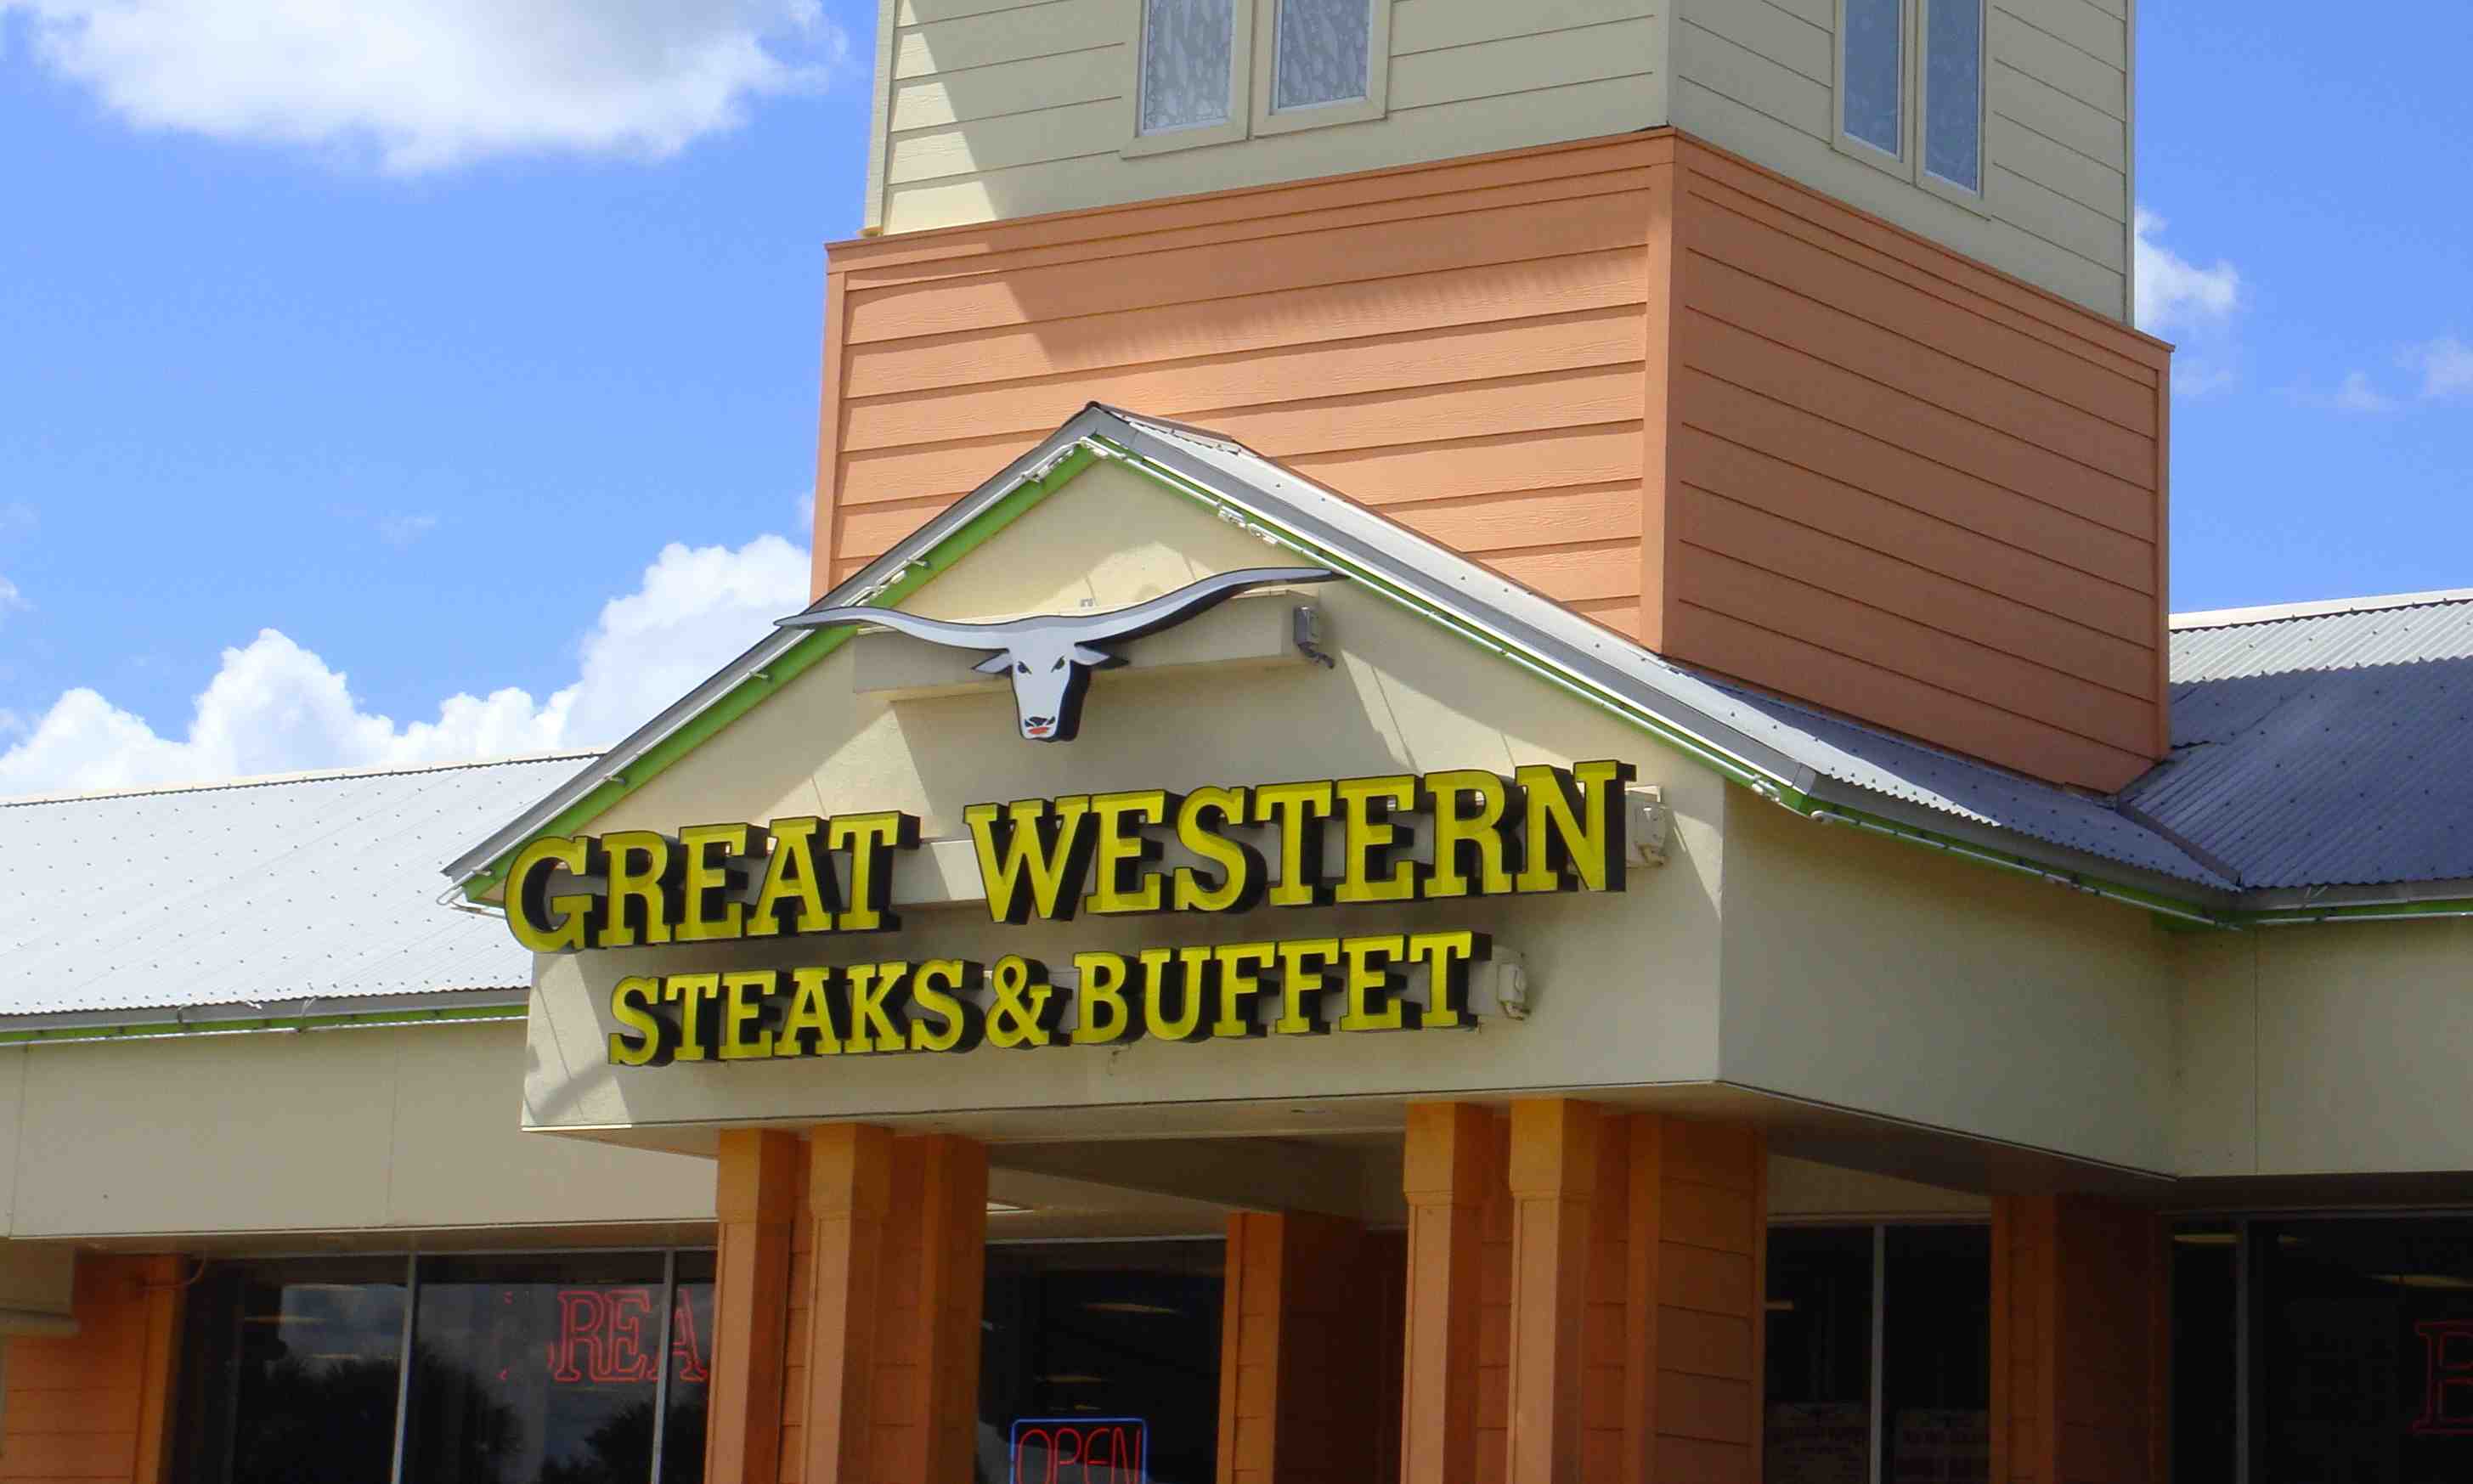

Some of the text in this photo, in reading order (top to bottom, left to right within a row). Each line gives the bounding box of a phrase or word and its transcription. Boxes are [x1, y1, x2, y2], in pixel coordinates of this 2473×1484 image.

[505, 760, 1626, 952] GREAT WESTERN
[608, 930, 1482, 1067] STEAKS & BUFFET
[548, 1288, 708, 1383] REA
[1015, 1427, 1142, 1484] OPEN
